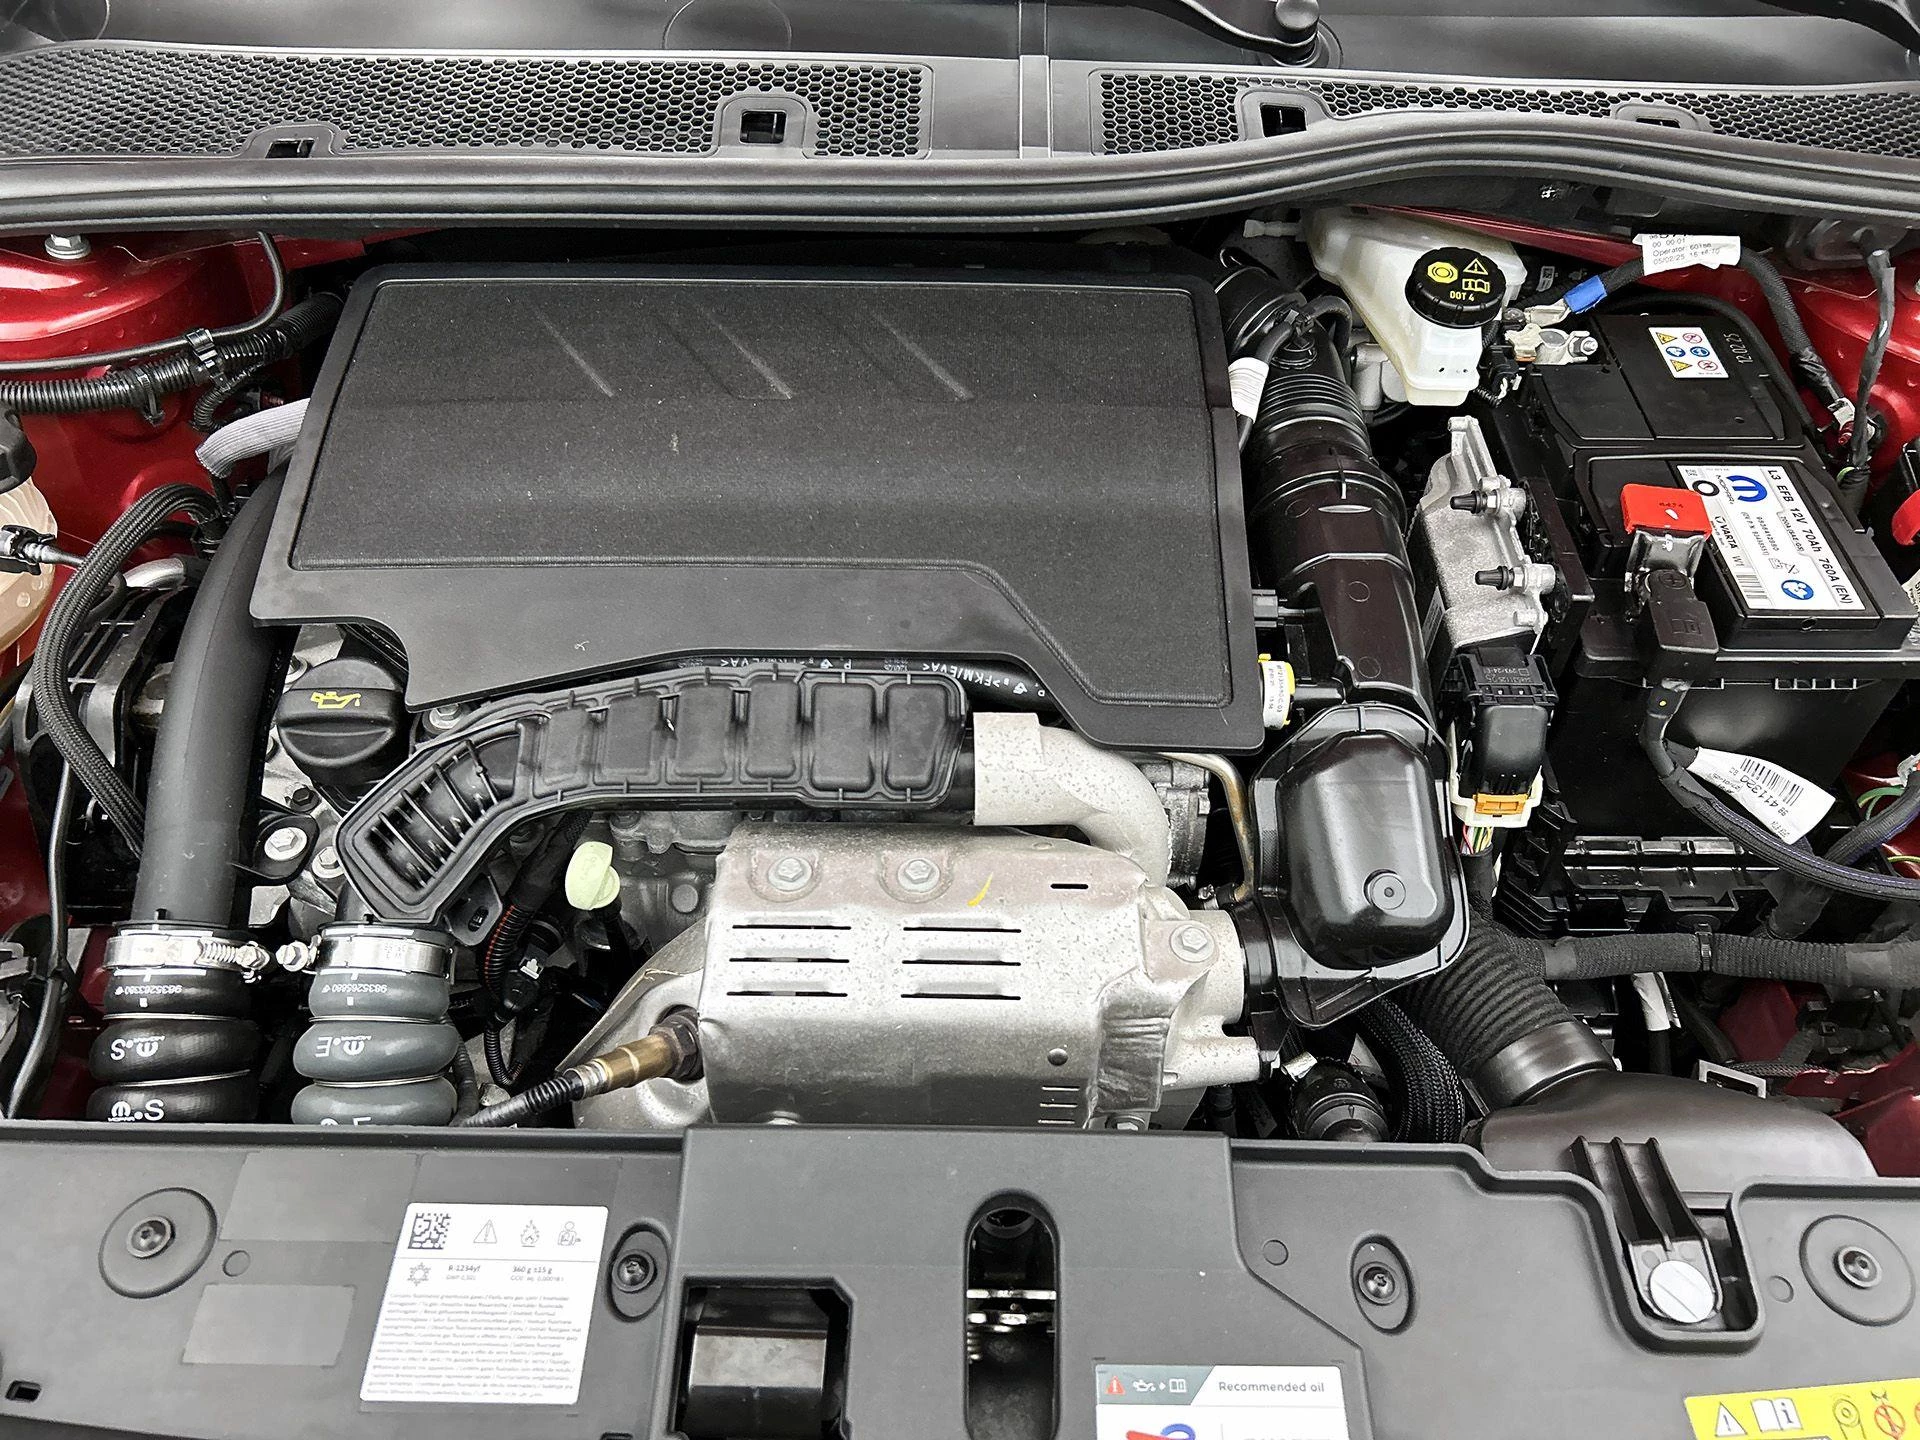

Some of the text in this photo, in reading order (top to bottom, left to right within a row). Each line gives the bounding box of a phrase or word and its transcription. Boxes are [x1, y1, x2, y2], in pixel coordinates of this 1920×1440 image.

[1449, 290, 1475, 302] DOT 4
[1719, 518, 1739, 550] VARTA
[1767, 469, 1854, 604] L3 EFB 12V 70Ah 760A (EN)
[144, 1099, 164, 1121] S
[512, 1265, 525, 1273] 360
[1218, 1381, 1325, 1393] Recommended oil
